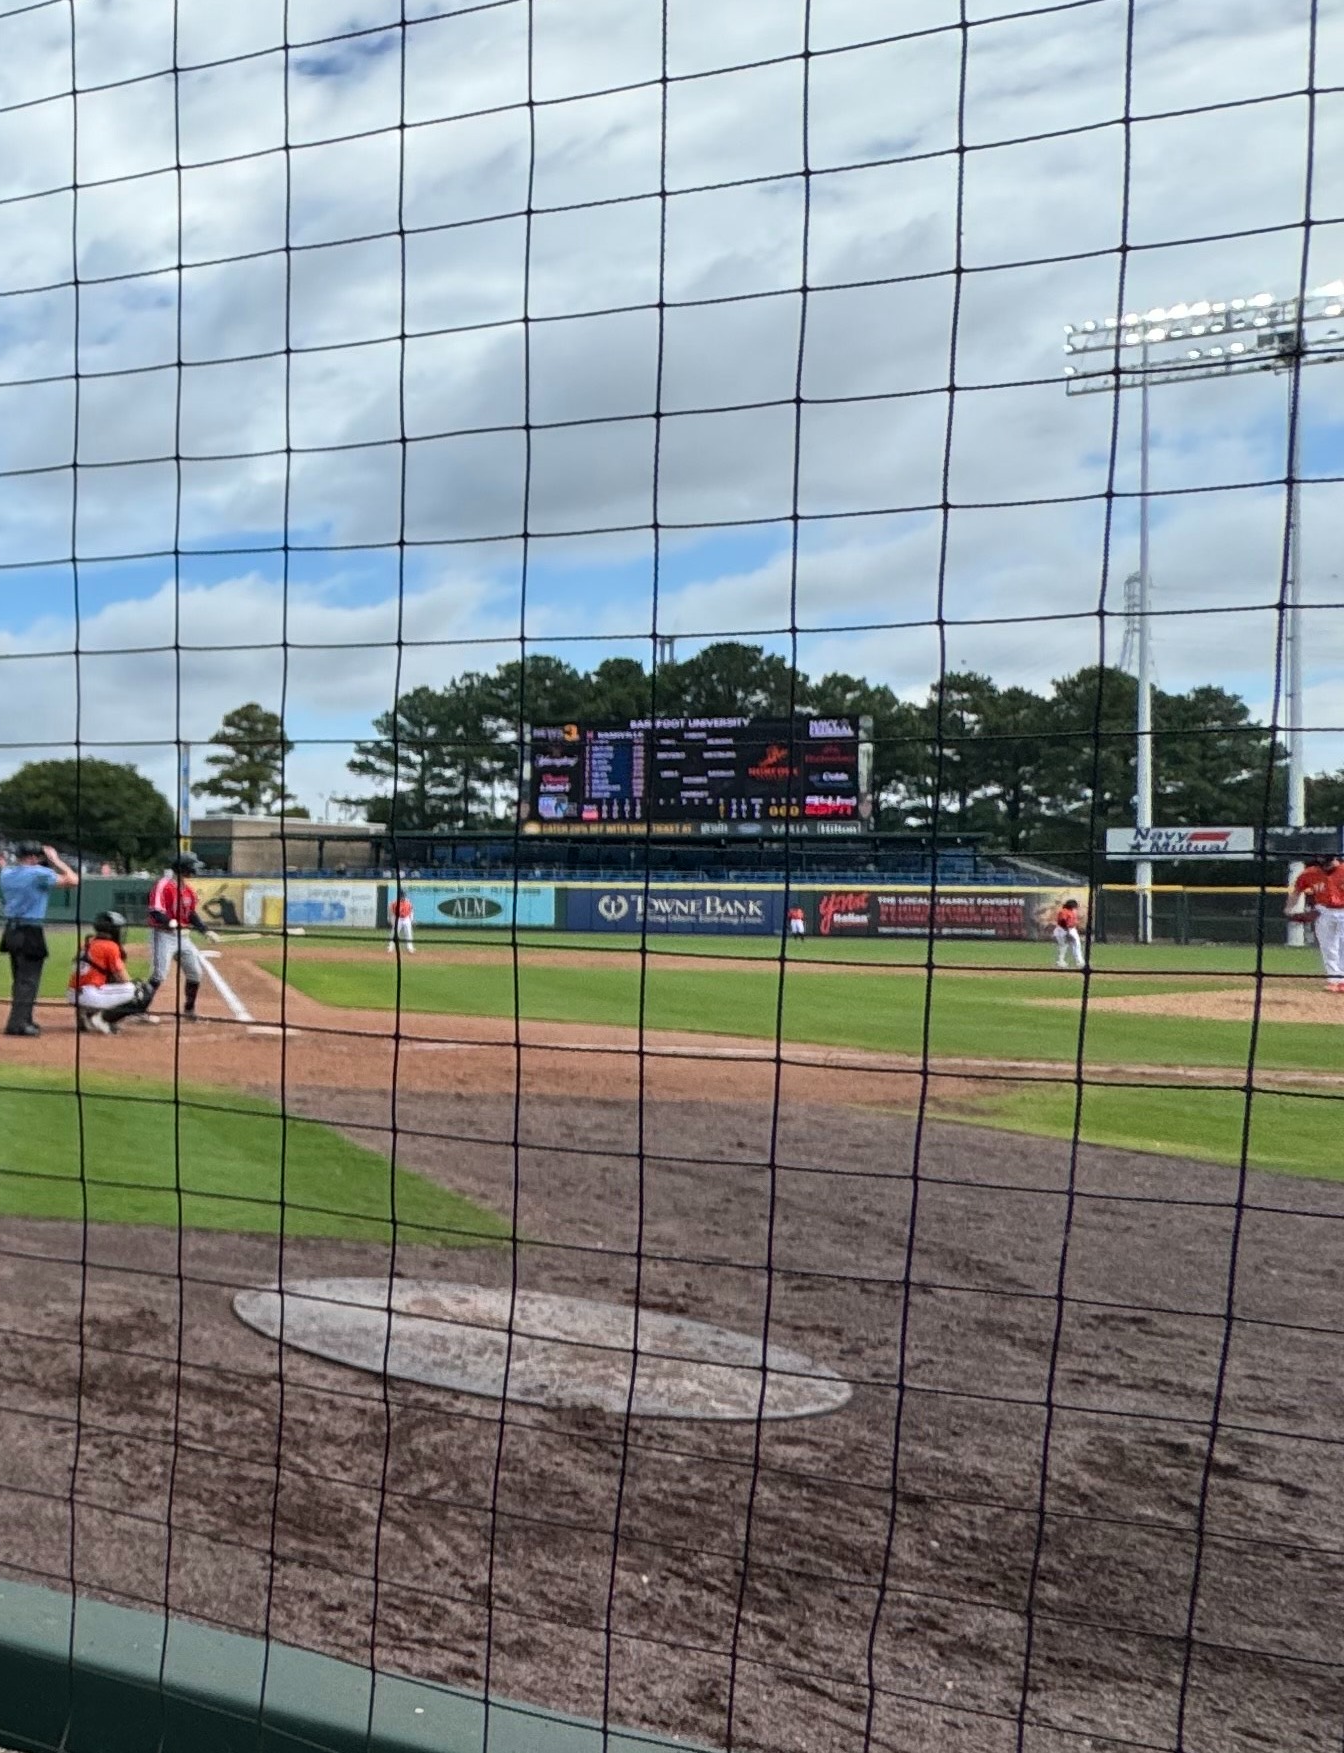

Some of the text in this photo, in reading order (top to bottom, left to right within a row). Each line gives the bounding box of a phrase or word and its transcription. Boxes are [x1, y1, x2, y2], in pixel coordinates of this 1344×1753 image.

[820, 823, 858, 834] Hilton
[1133, 827, 1189, 843] Navy
[1149, 840, 1229, 853] Mutual
[452, 897, 486, 918] ALM
